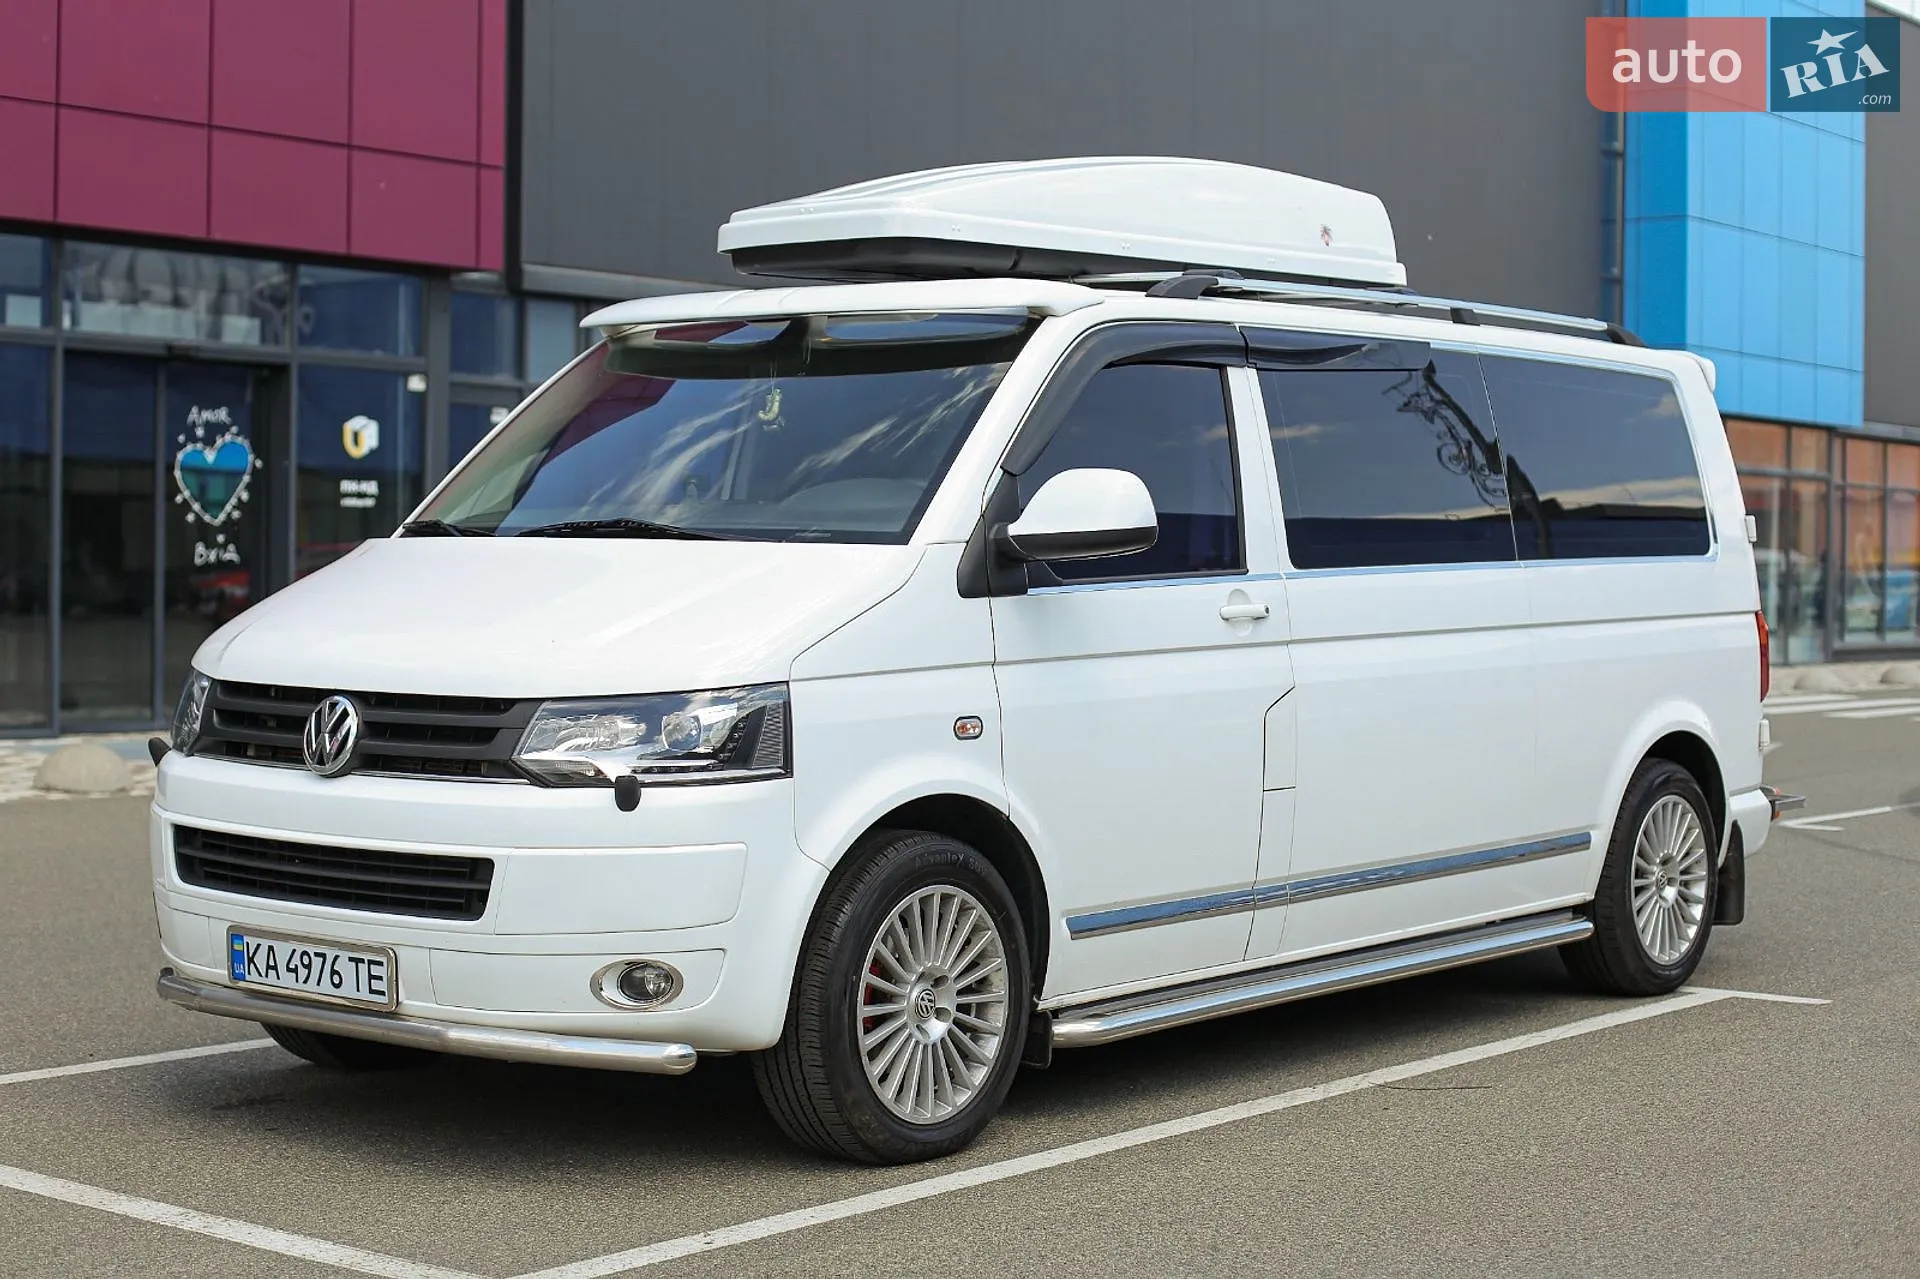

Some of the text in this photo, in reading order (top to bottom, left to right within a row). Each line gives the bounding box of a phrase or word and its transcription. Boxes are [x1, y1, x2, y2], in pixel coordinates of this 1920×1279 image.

[246, 941, 386, 997] KA 4976 TE
